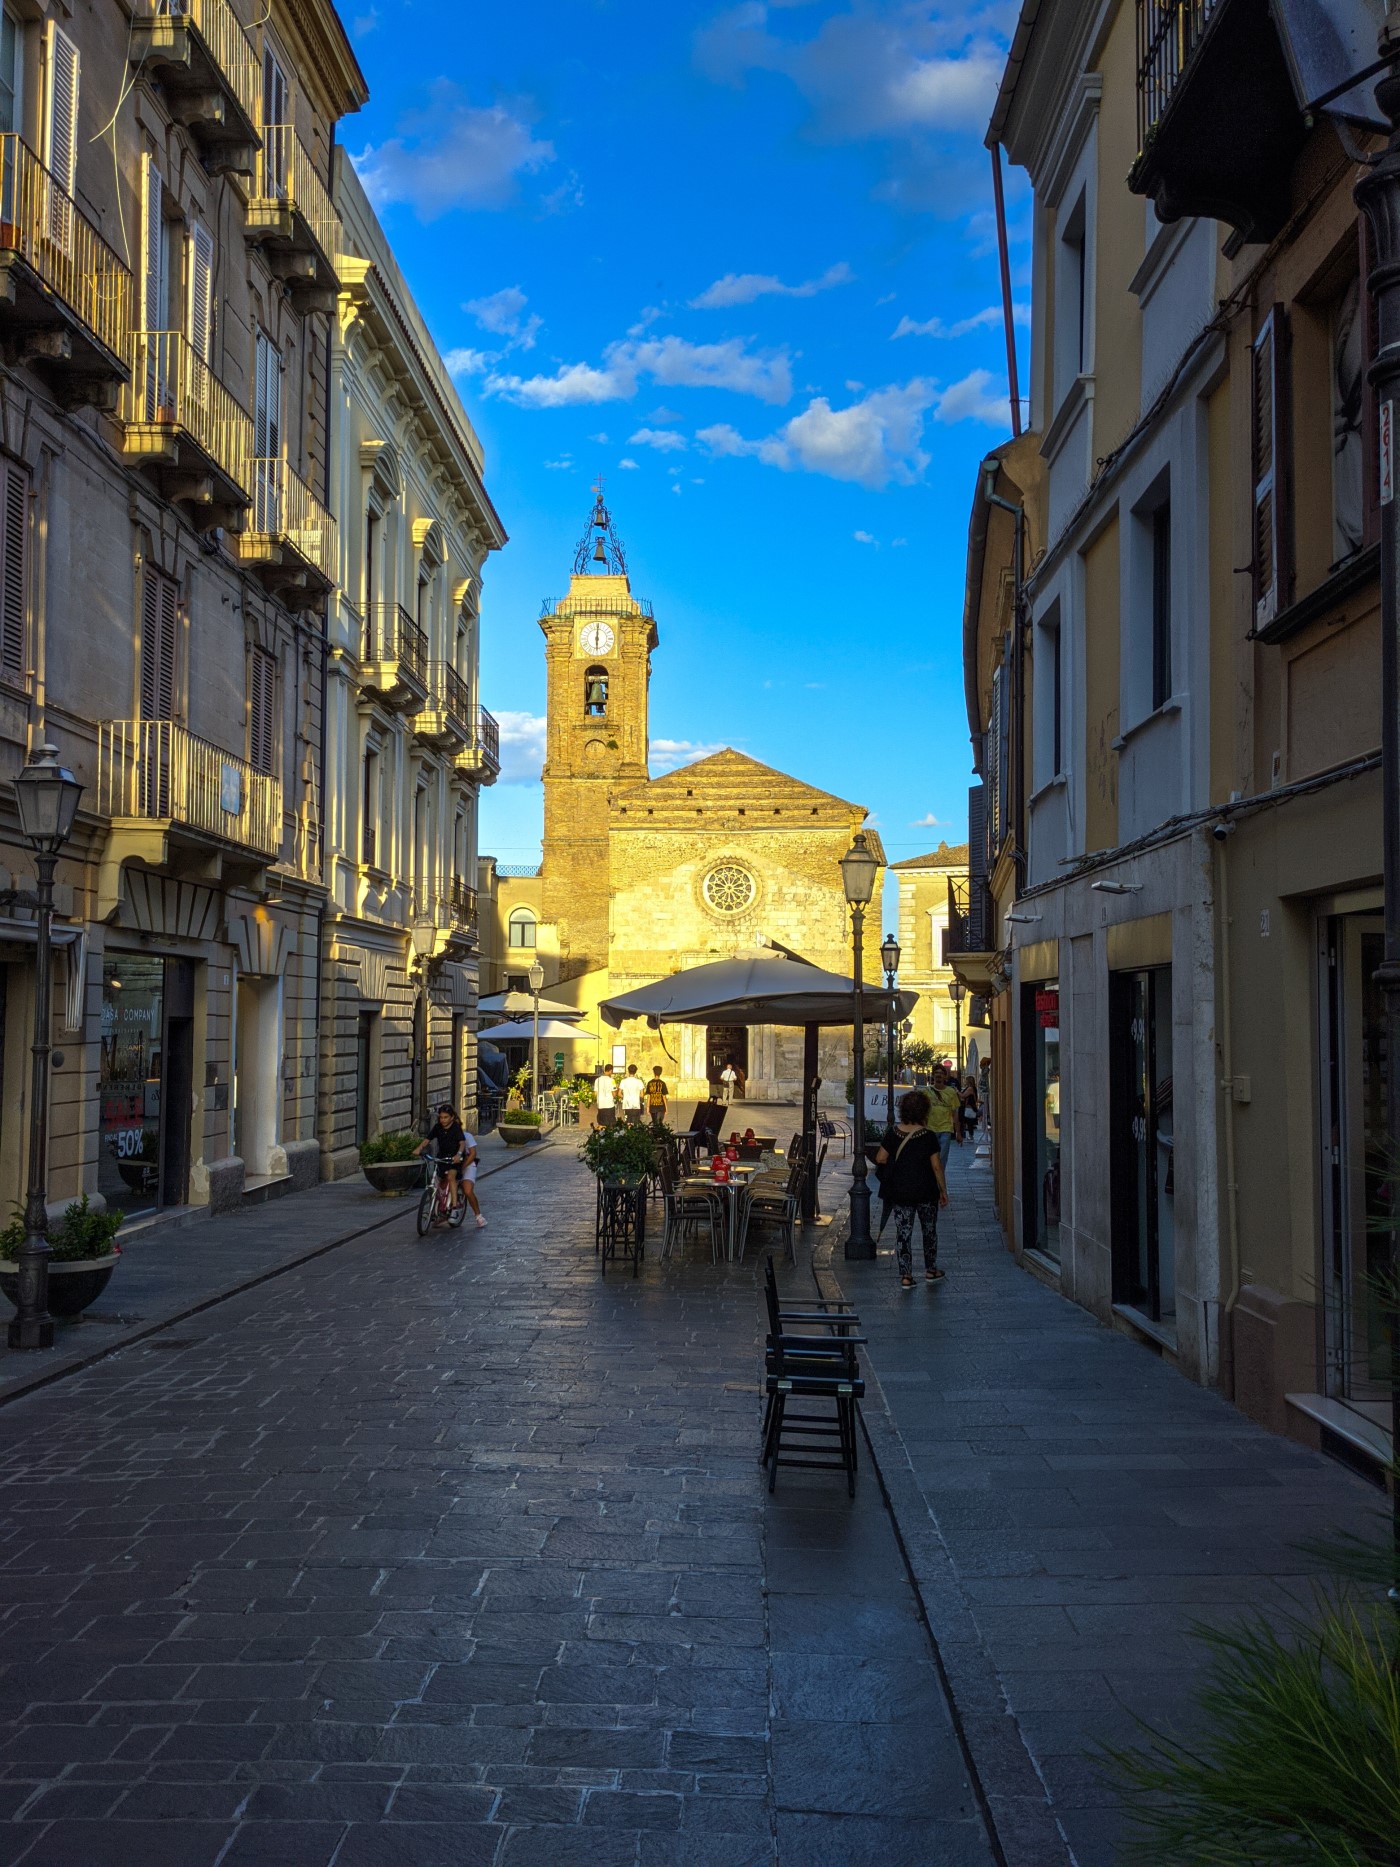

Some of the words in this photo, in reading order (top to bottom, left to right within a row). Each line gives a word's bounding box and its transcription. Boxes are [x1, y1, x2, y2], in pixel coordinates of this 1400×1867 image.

[1382, 405, 1390, 488] 2614
[123, 1008, 154, 1021] COMPANY
[117, 1129, 144, 1158] 50%
